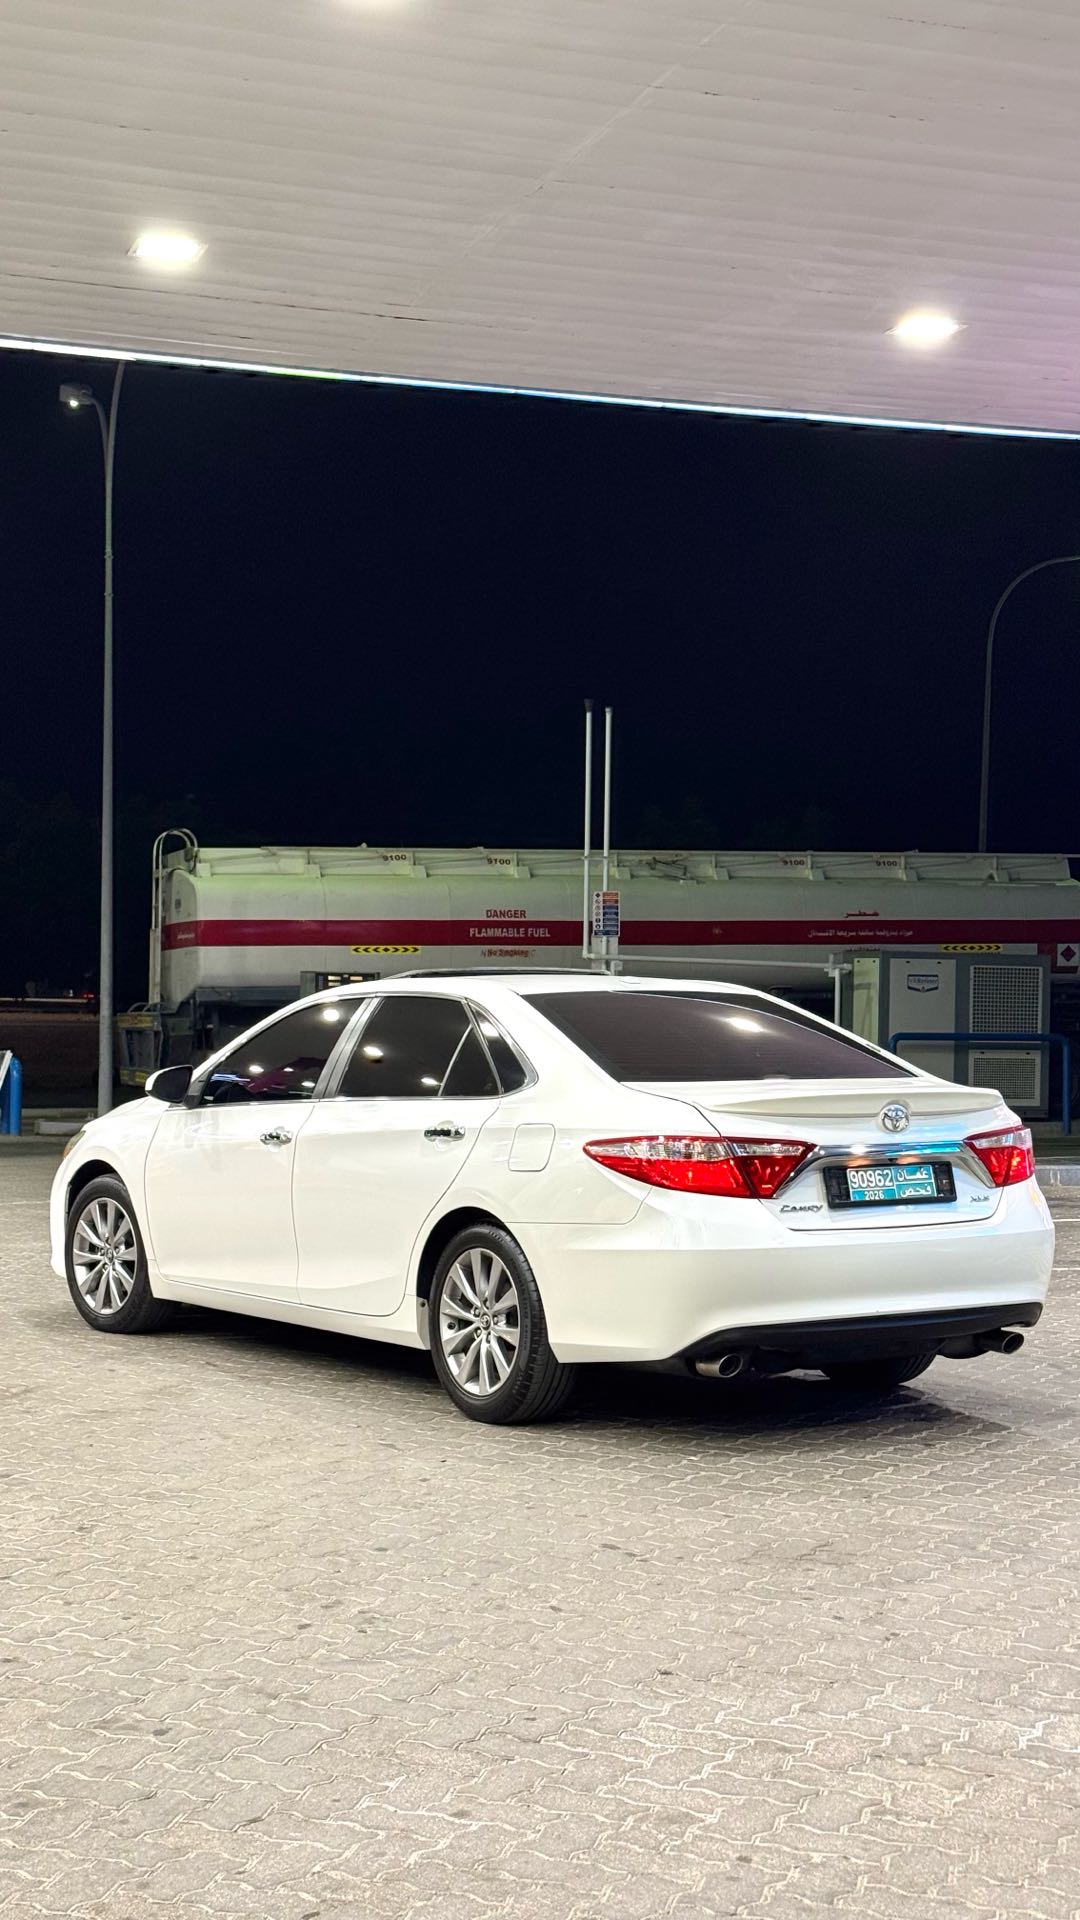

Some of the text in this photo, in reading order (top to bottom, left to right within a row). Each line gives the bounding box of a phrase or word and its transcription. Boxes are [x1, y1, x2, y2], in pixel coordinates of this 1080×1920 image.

[382, 854, 407, 862] 9100
[487, 857, 511, 865] 9100
[485, 909, 527, 919] DANGER
[469, 928, 551, 938] FLAMMABLE FUEL
[849, 1169, 894, 1189] 90962
[864, 1190, 885, 1201] 2026
[900, 1183, 932, 1198] فحص
